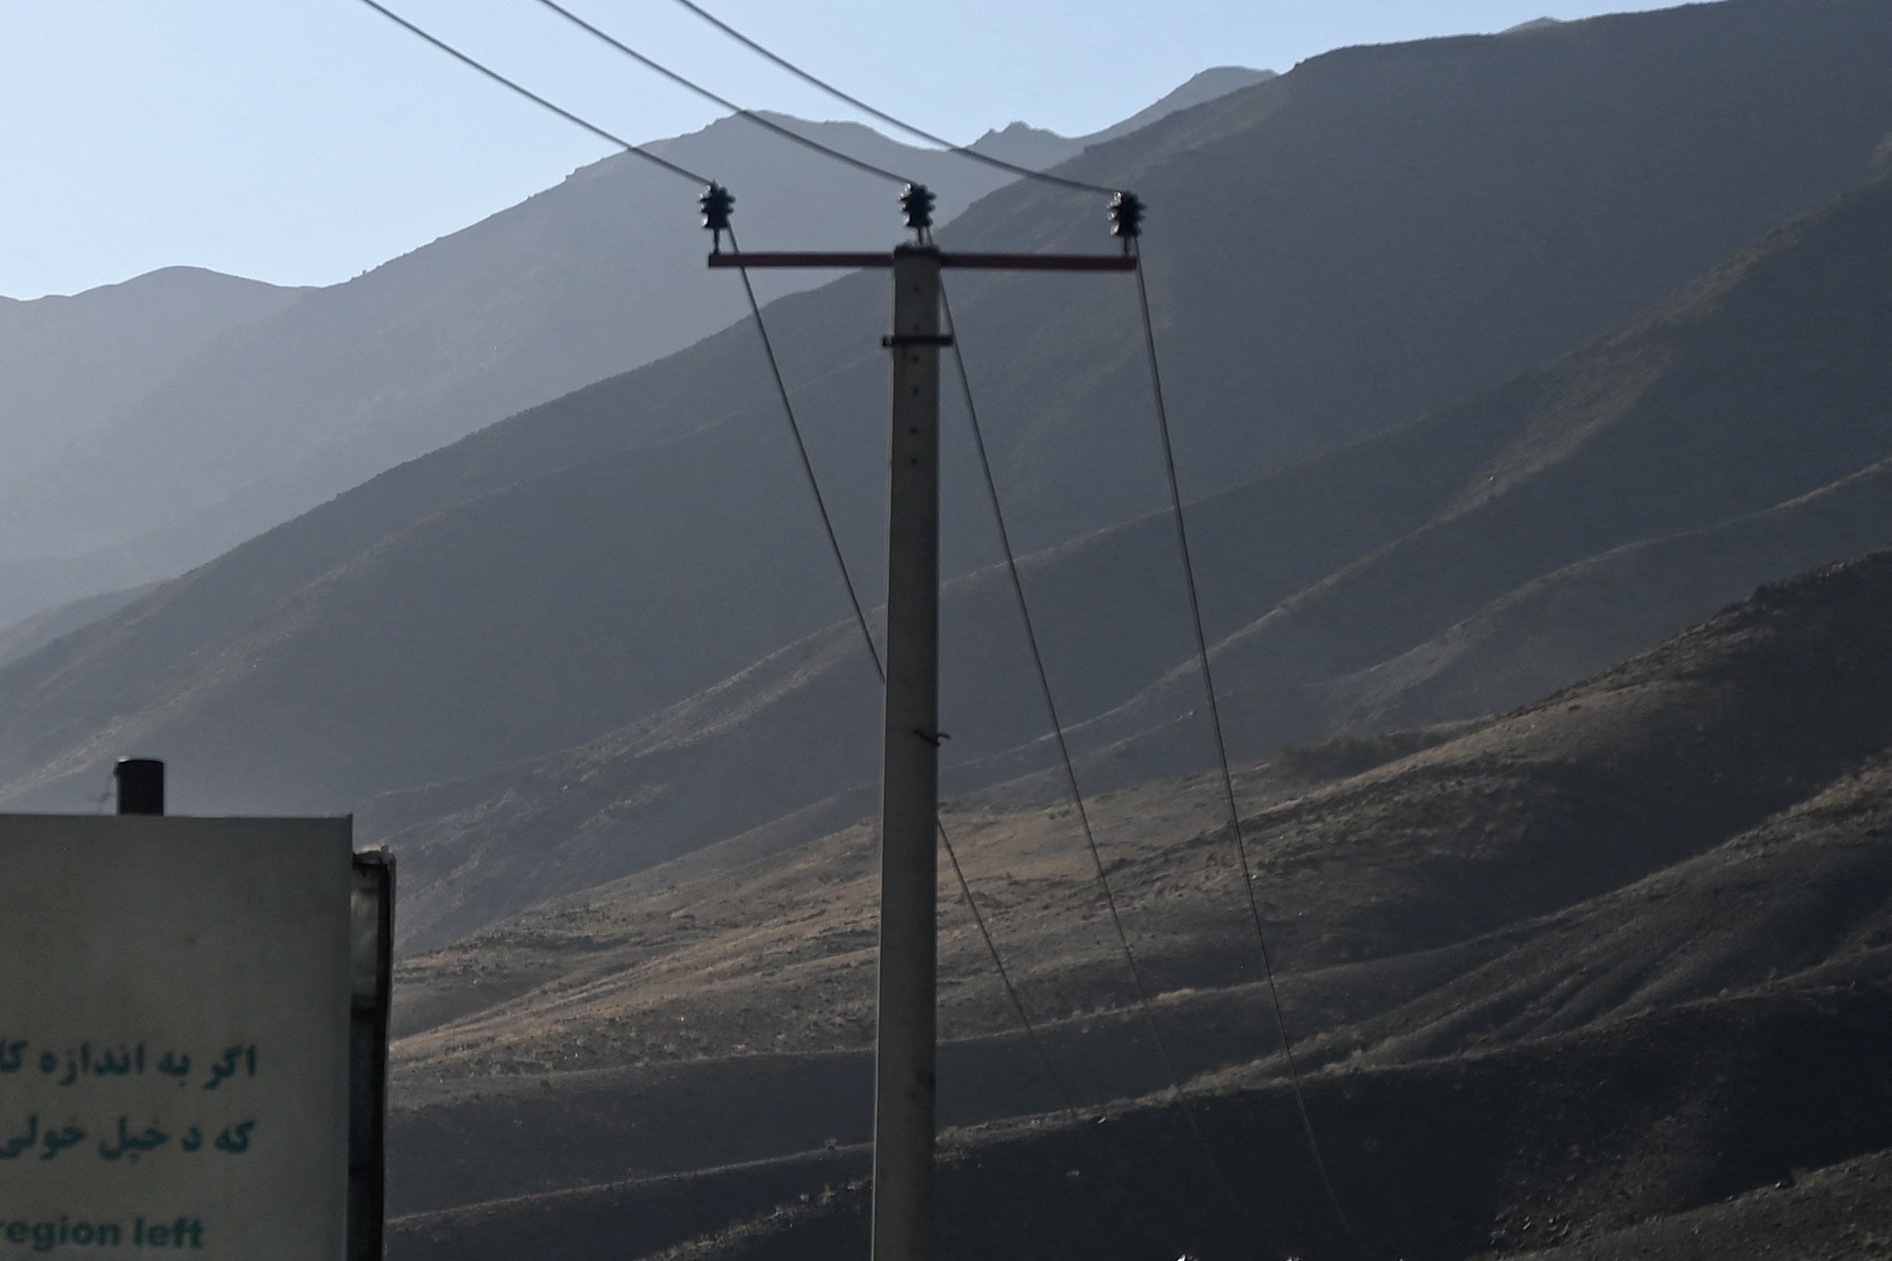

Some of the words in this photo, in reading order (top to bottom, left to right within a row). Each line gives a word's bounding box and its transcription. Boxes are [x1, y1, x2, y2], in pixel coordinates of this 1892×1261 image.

[39, 1041, 147, 1088] اندازه
[156, 1050, 192, 1087] به
[204, 1042, 258, 1090] اگر
[180, 1126, 203, 1153] د
[213, 1119, 257, 1155] که
[133, 1216, 205, 1250] left
